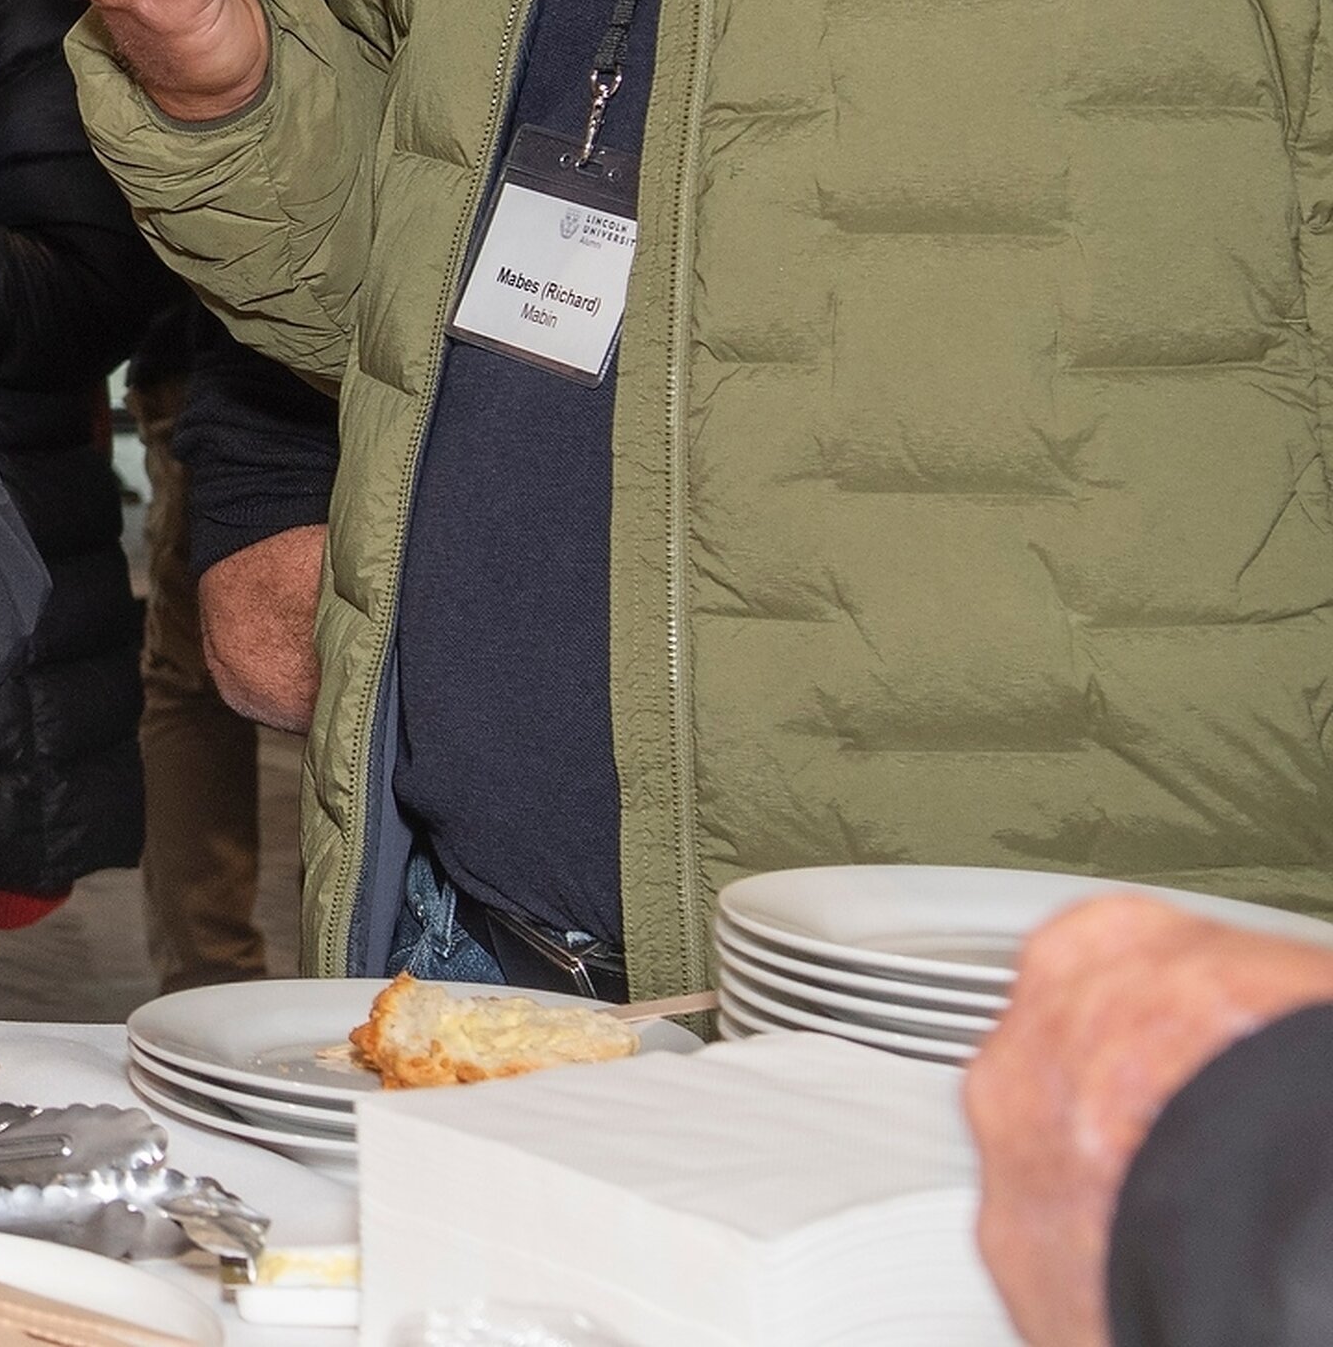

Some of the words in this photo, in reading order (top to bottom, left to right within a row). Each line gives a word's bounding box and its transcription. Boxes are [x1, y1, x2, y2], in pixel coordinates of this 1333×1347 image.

[585, 214, 629, 232] LINCOLN
[582, 225, 636, 247] UNIVERSIT
[497, 266, 540, 294] Mabes
[541, 280, 602, 317] (Richard)
[520, 302, 558, 328] Mabin
